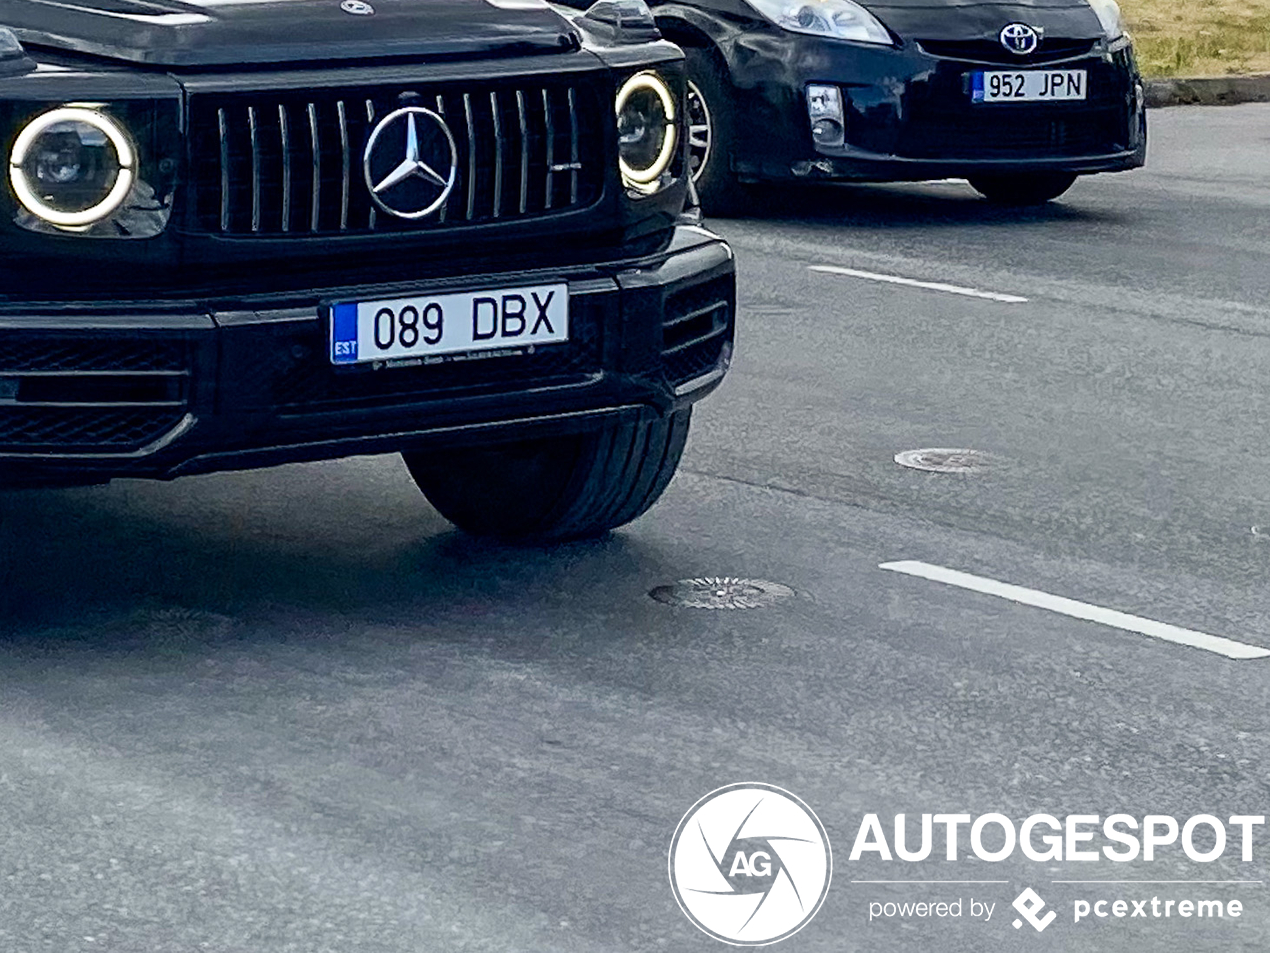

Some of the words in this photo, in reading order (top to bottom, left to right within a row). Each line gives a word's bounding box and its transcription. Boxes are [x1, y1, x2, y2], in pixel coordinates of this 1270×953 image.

[989, 74, 1025, 97] 952
[1038, 73, 1081, 96] JPN
[373, 302, 444, 350] 089
[472, 290, 555, 341] DBX
[335, 340, 357, 355] EST
